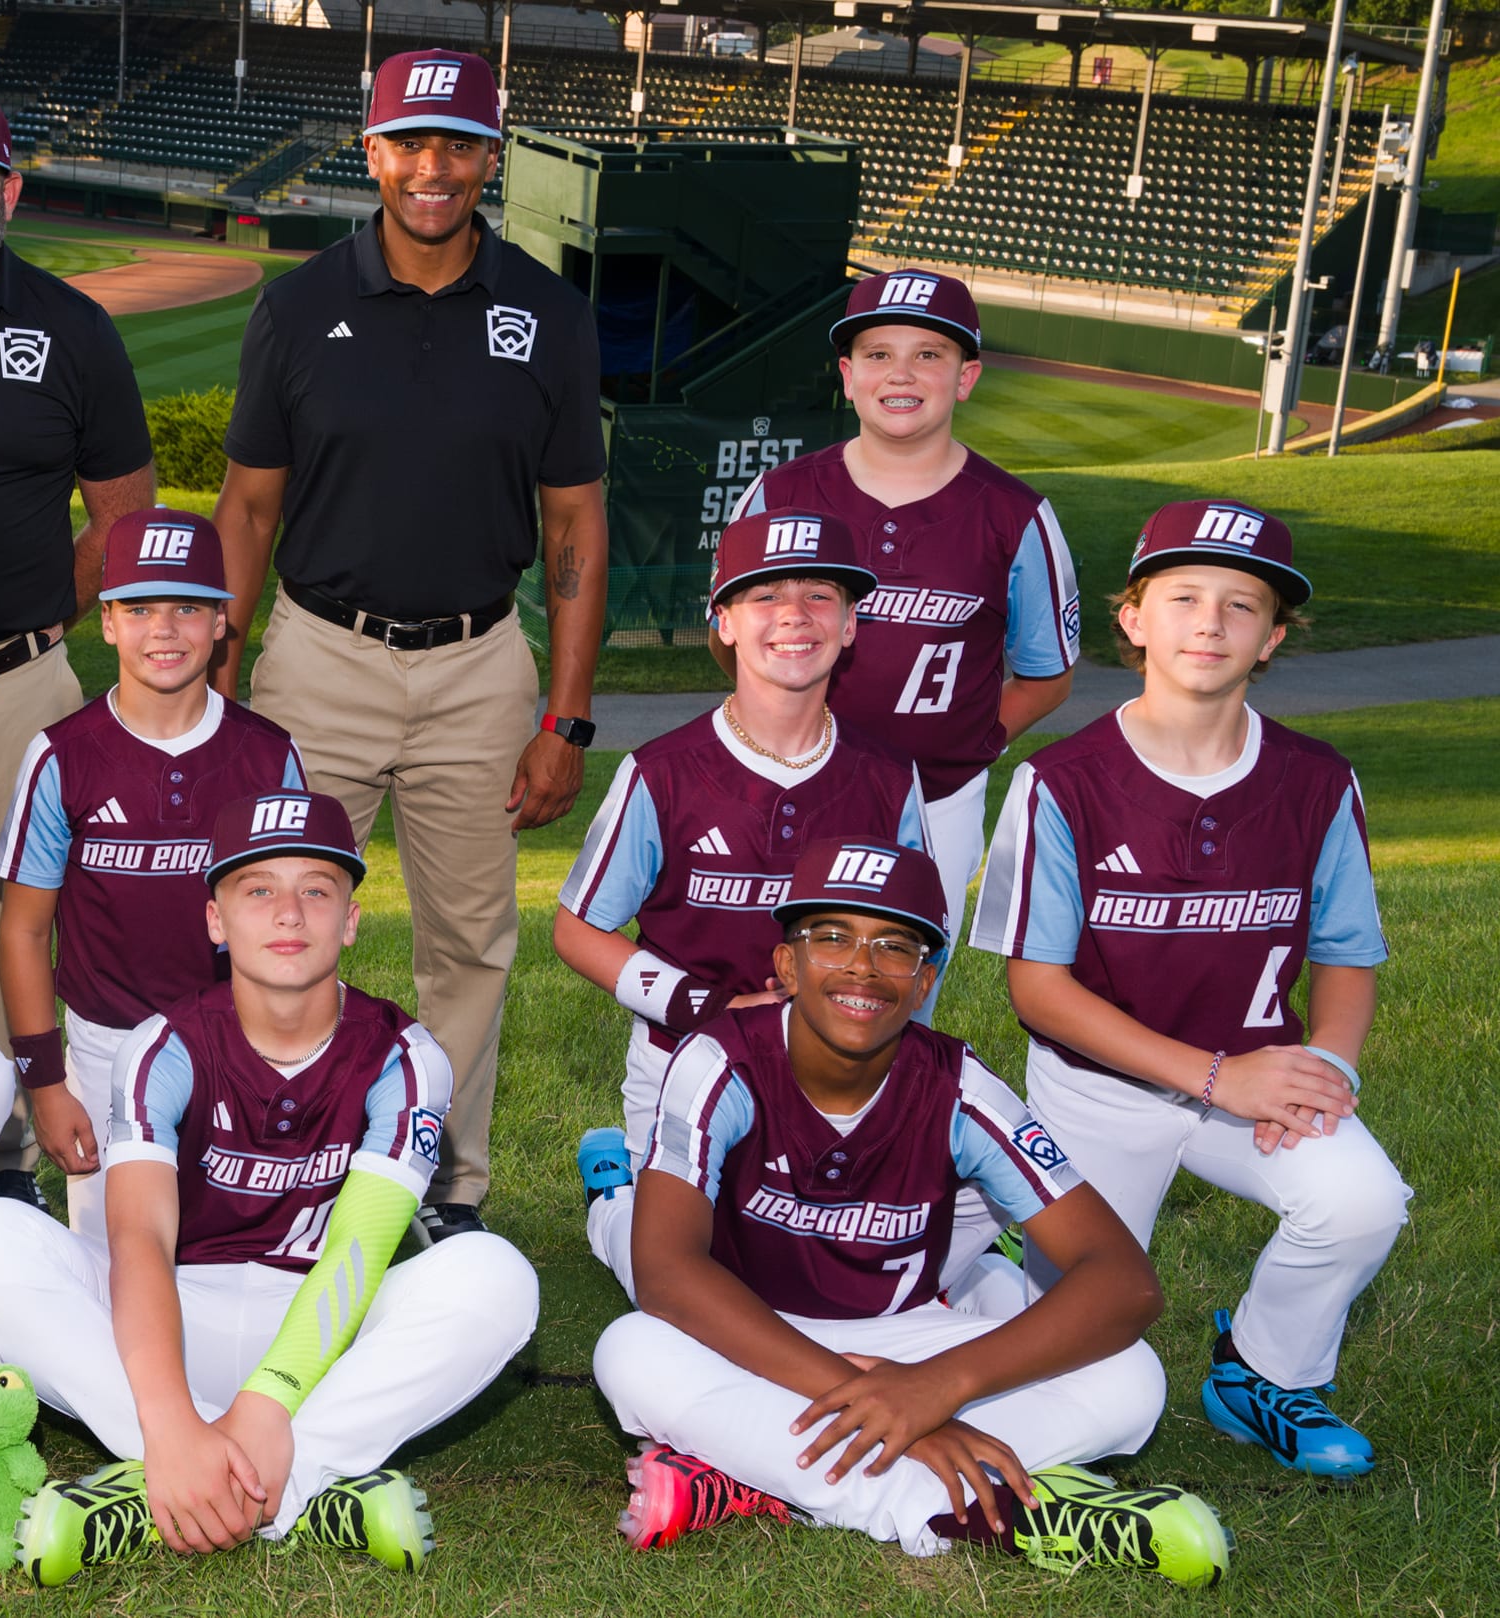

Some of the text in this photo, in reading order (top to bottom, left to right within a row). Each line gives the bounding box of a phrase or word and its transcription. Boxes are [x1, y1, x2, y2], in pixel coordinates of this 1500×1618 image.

[403, 66, 460, 97] ne
[878, 277, 938, 306] ne
[716, 438, 804, 478] BEST
[138, 527, 195, 559] ne
[764, 521, 822, 555] ne
[1193, 509, 1263, 547] ne
[855, 588, 985, 623] england
[893, 641, 966, 714] 13
[250, 799, 311, 834] ne
[81, 842, 145, 869] new
[826, 849, 897, 887] ne
[687, 873, 752, 905] new
[1089, 887, 1303, 933] new england
[798, 1201, 931, 1242] england
[877, 1249, 927, 1318] 7
